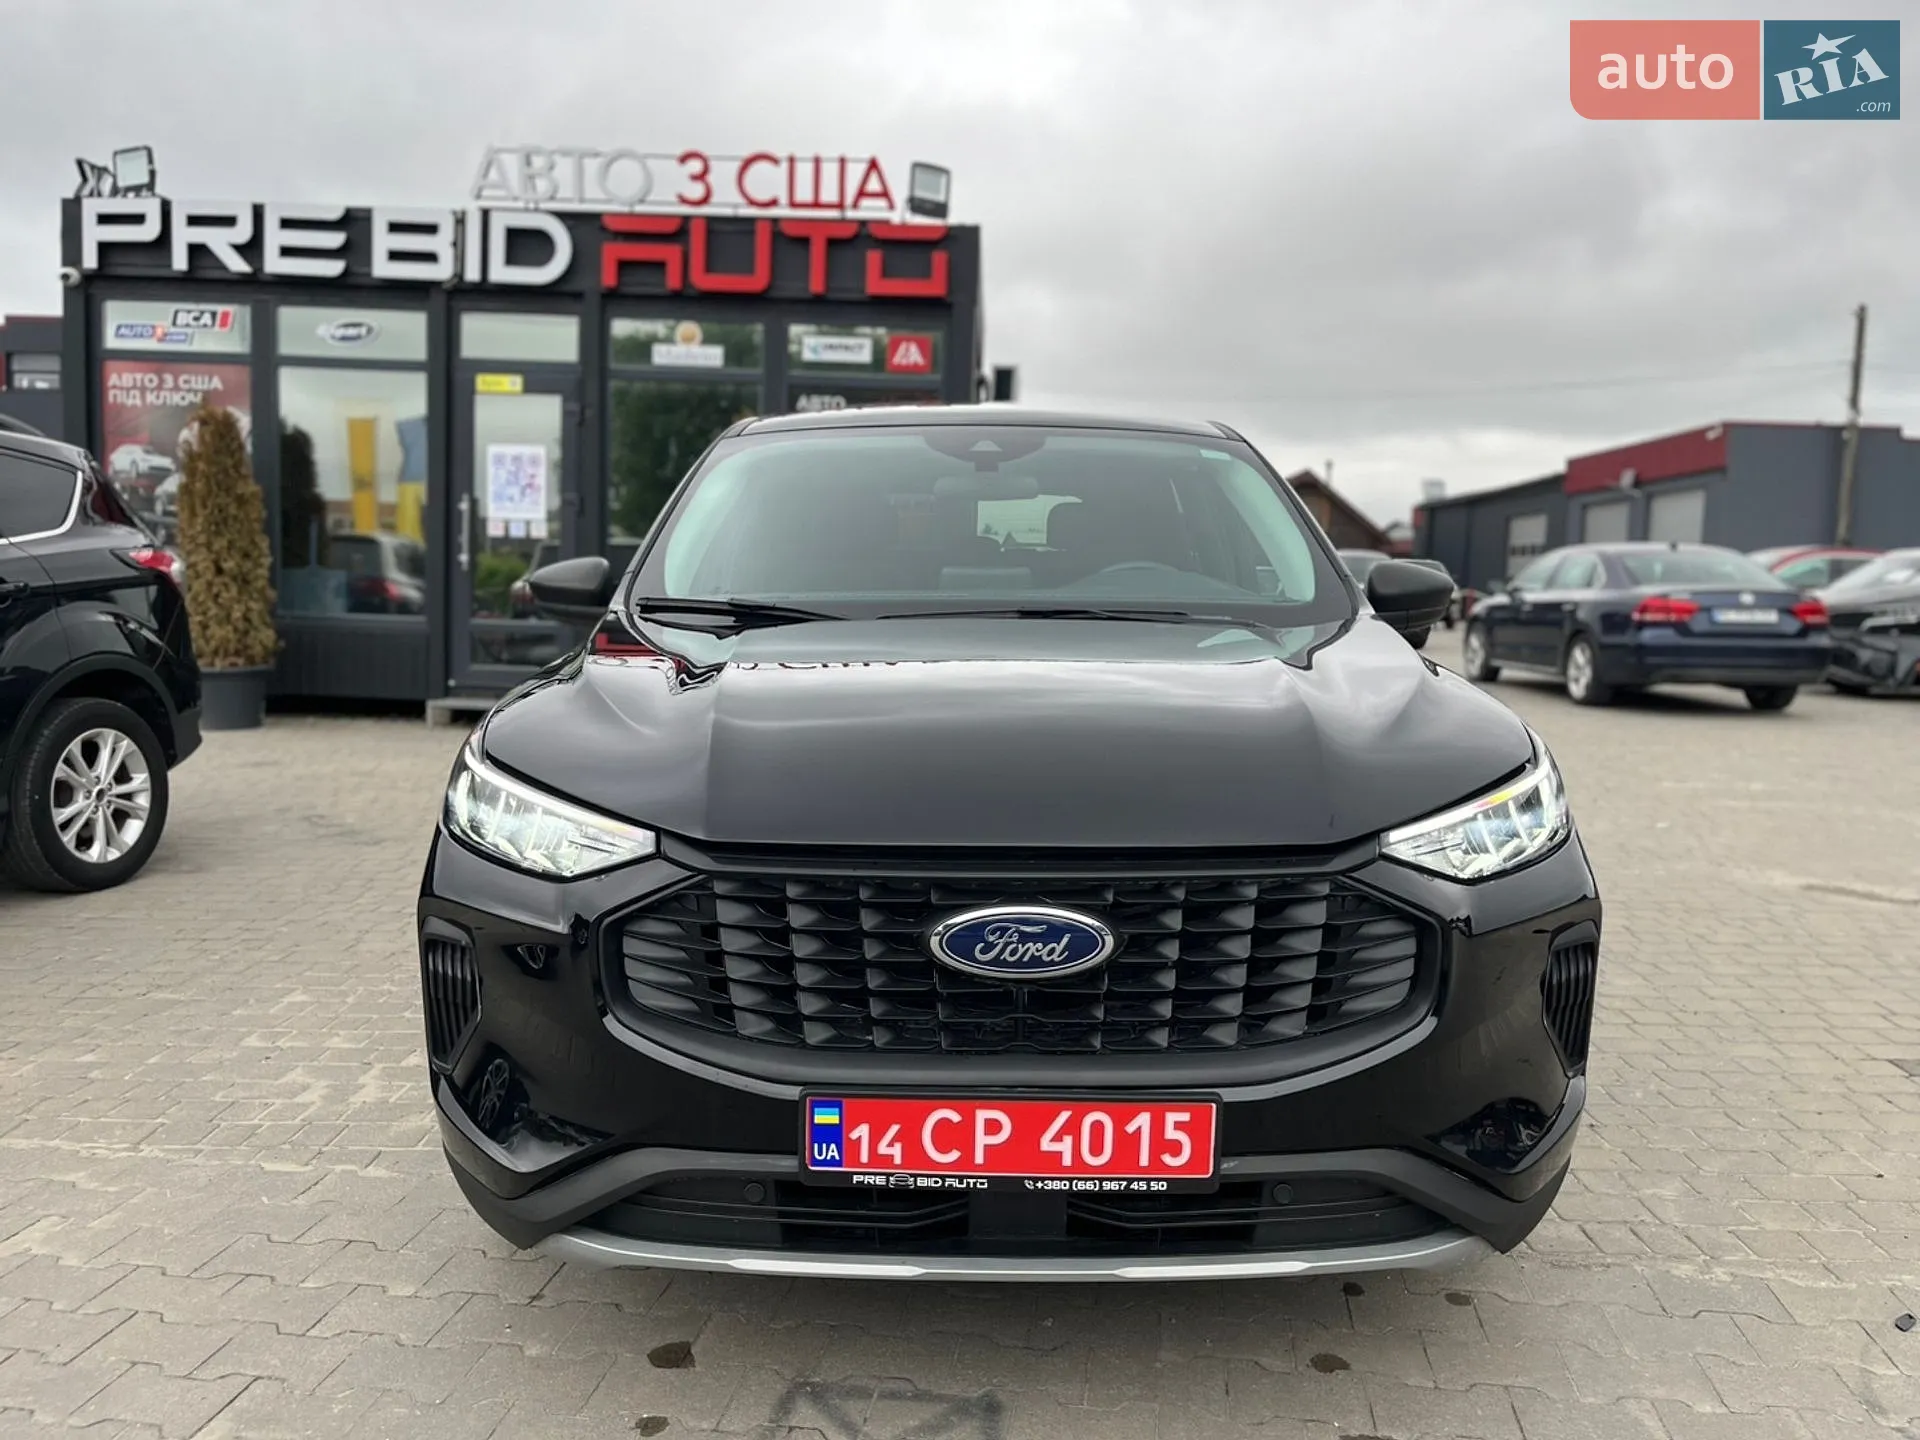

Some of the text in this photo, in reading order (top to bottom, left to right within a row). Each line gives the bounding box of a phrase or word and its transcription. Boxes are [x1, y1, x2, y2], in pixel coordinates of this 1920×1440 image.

[472, 147, 653, 205] АВТО
[736, 153, 895, 210] США
[82, 198, 949, 297] PRE BID AUTO
[108, 372, 160, 389] АВТО
[178, 374, 223, 391] США
[974, 922, 1072, 963] Ford
[813, 1142, 841, 1161] UA
[848, 1123, 903, 1165] 14
[1039, 1109, 1192, 1169] 4015
[852, 1174, 988, 1190] PRE BID AUTO
[1035, 1179, 1168, 1191] +380 (66) 967 45 50
